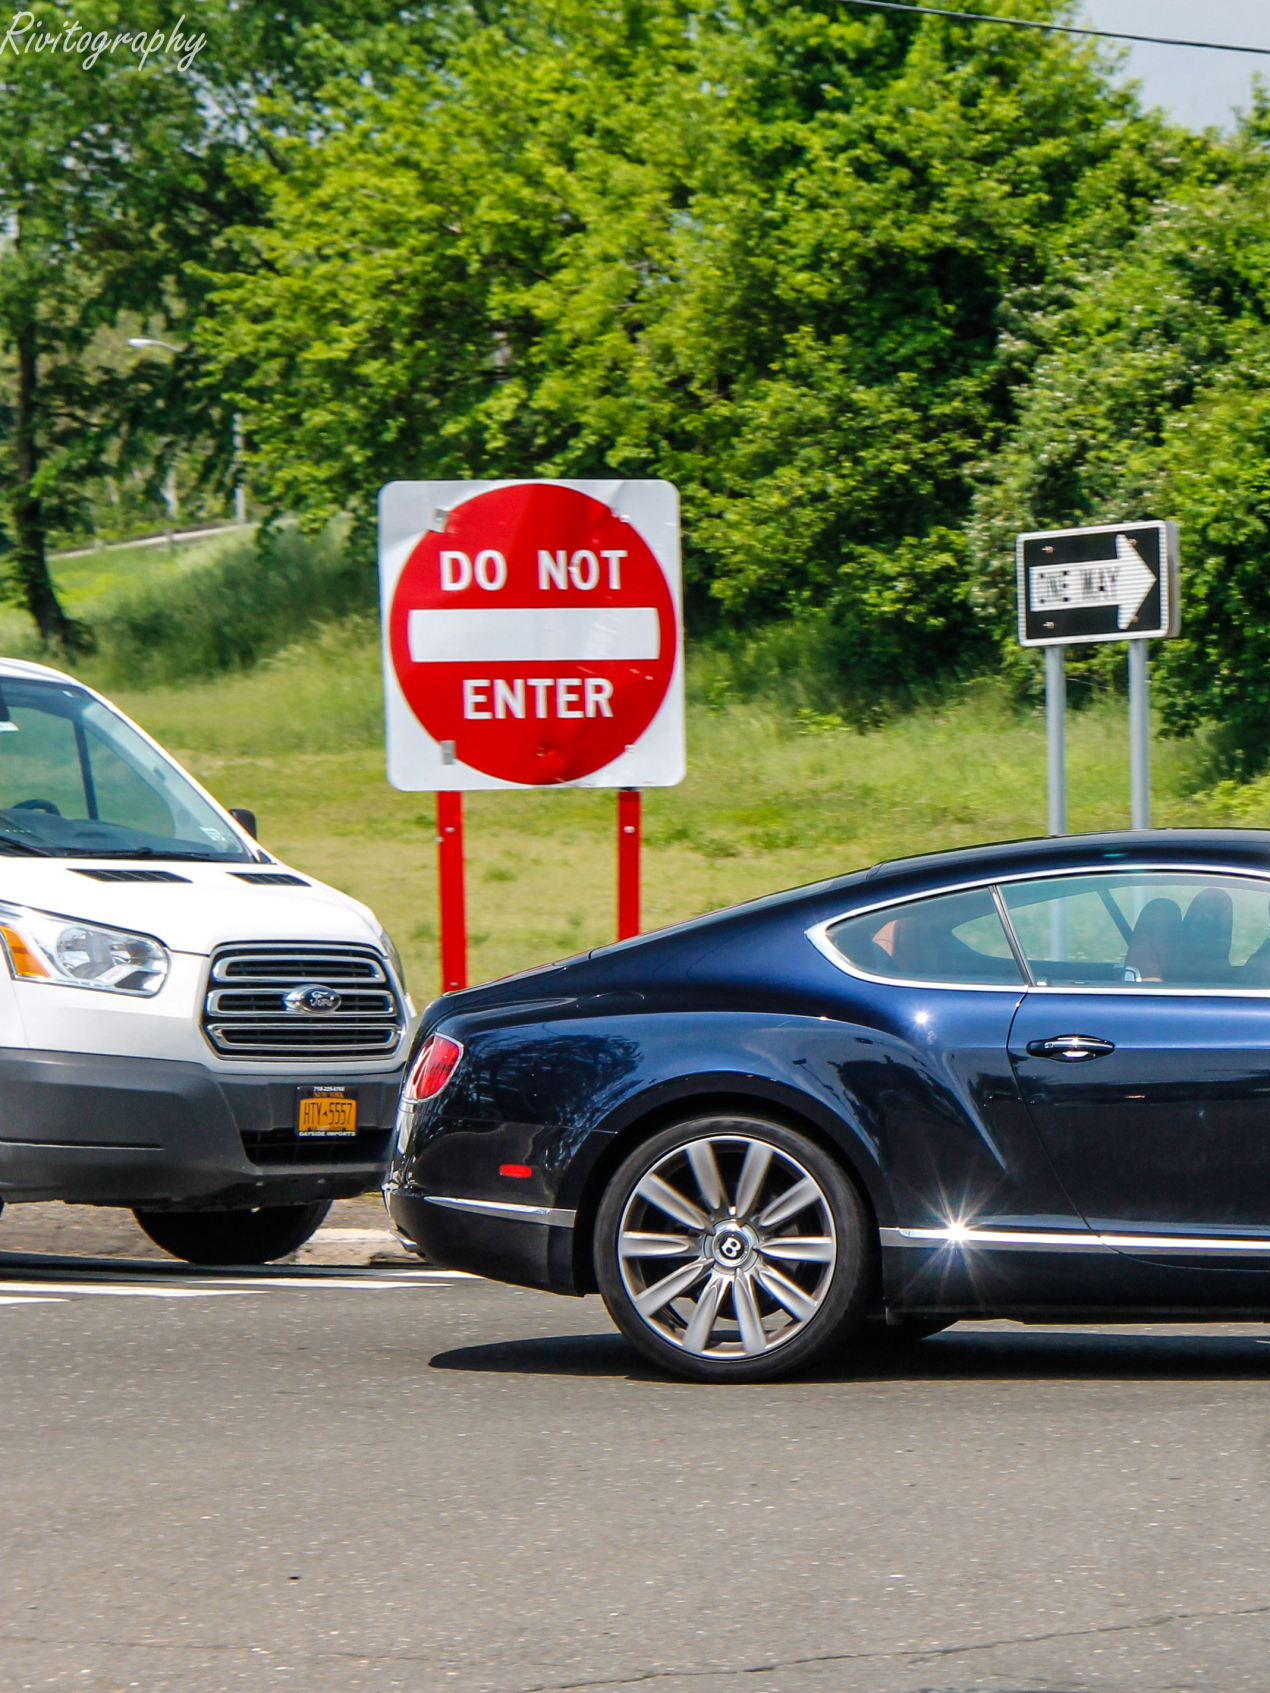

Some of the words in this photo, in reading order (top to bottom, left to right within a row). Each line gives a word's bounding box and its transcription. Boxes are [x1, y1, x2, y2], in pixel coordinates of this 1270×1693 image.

[439, 549, 508, 592] DO
[537, 549, 628, 591] NOT
[462, 677, 614, 720] ENTER
